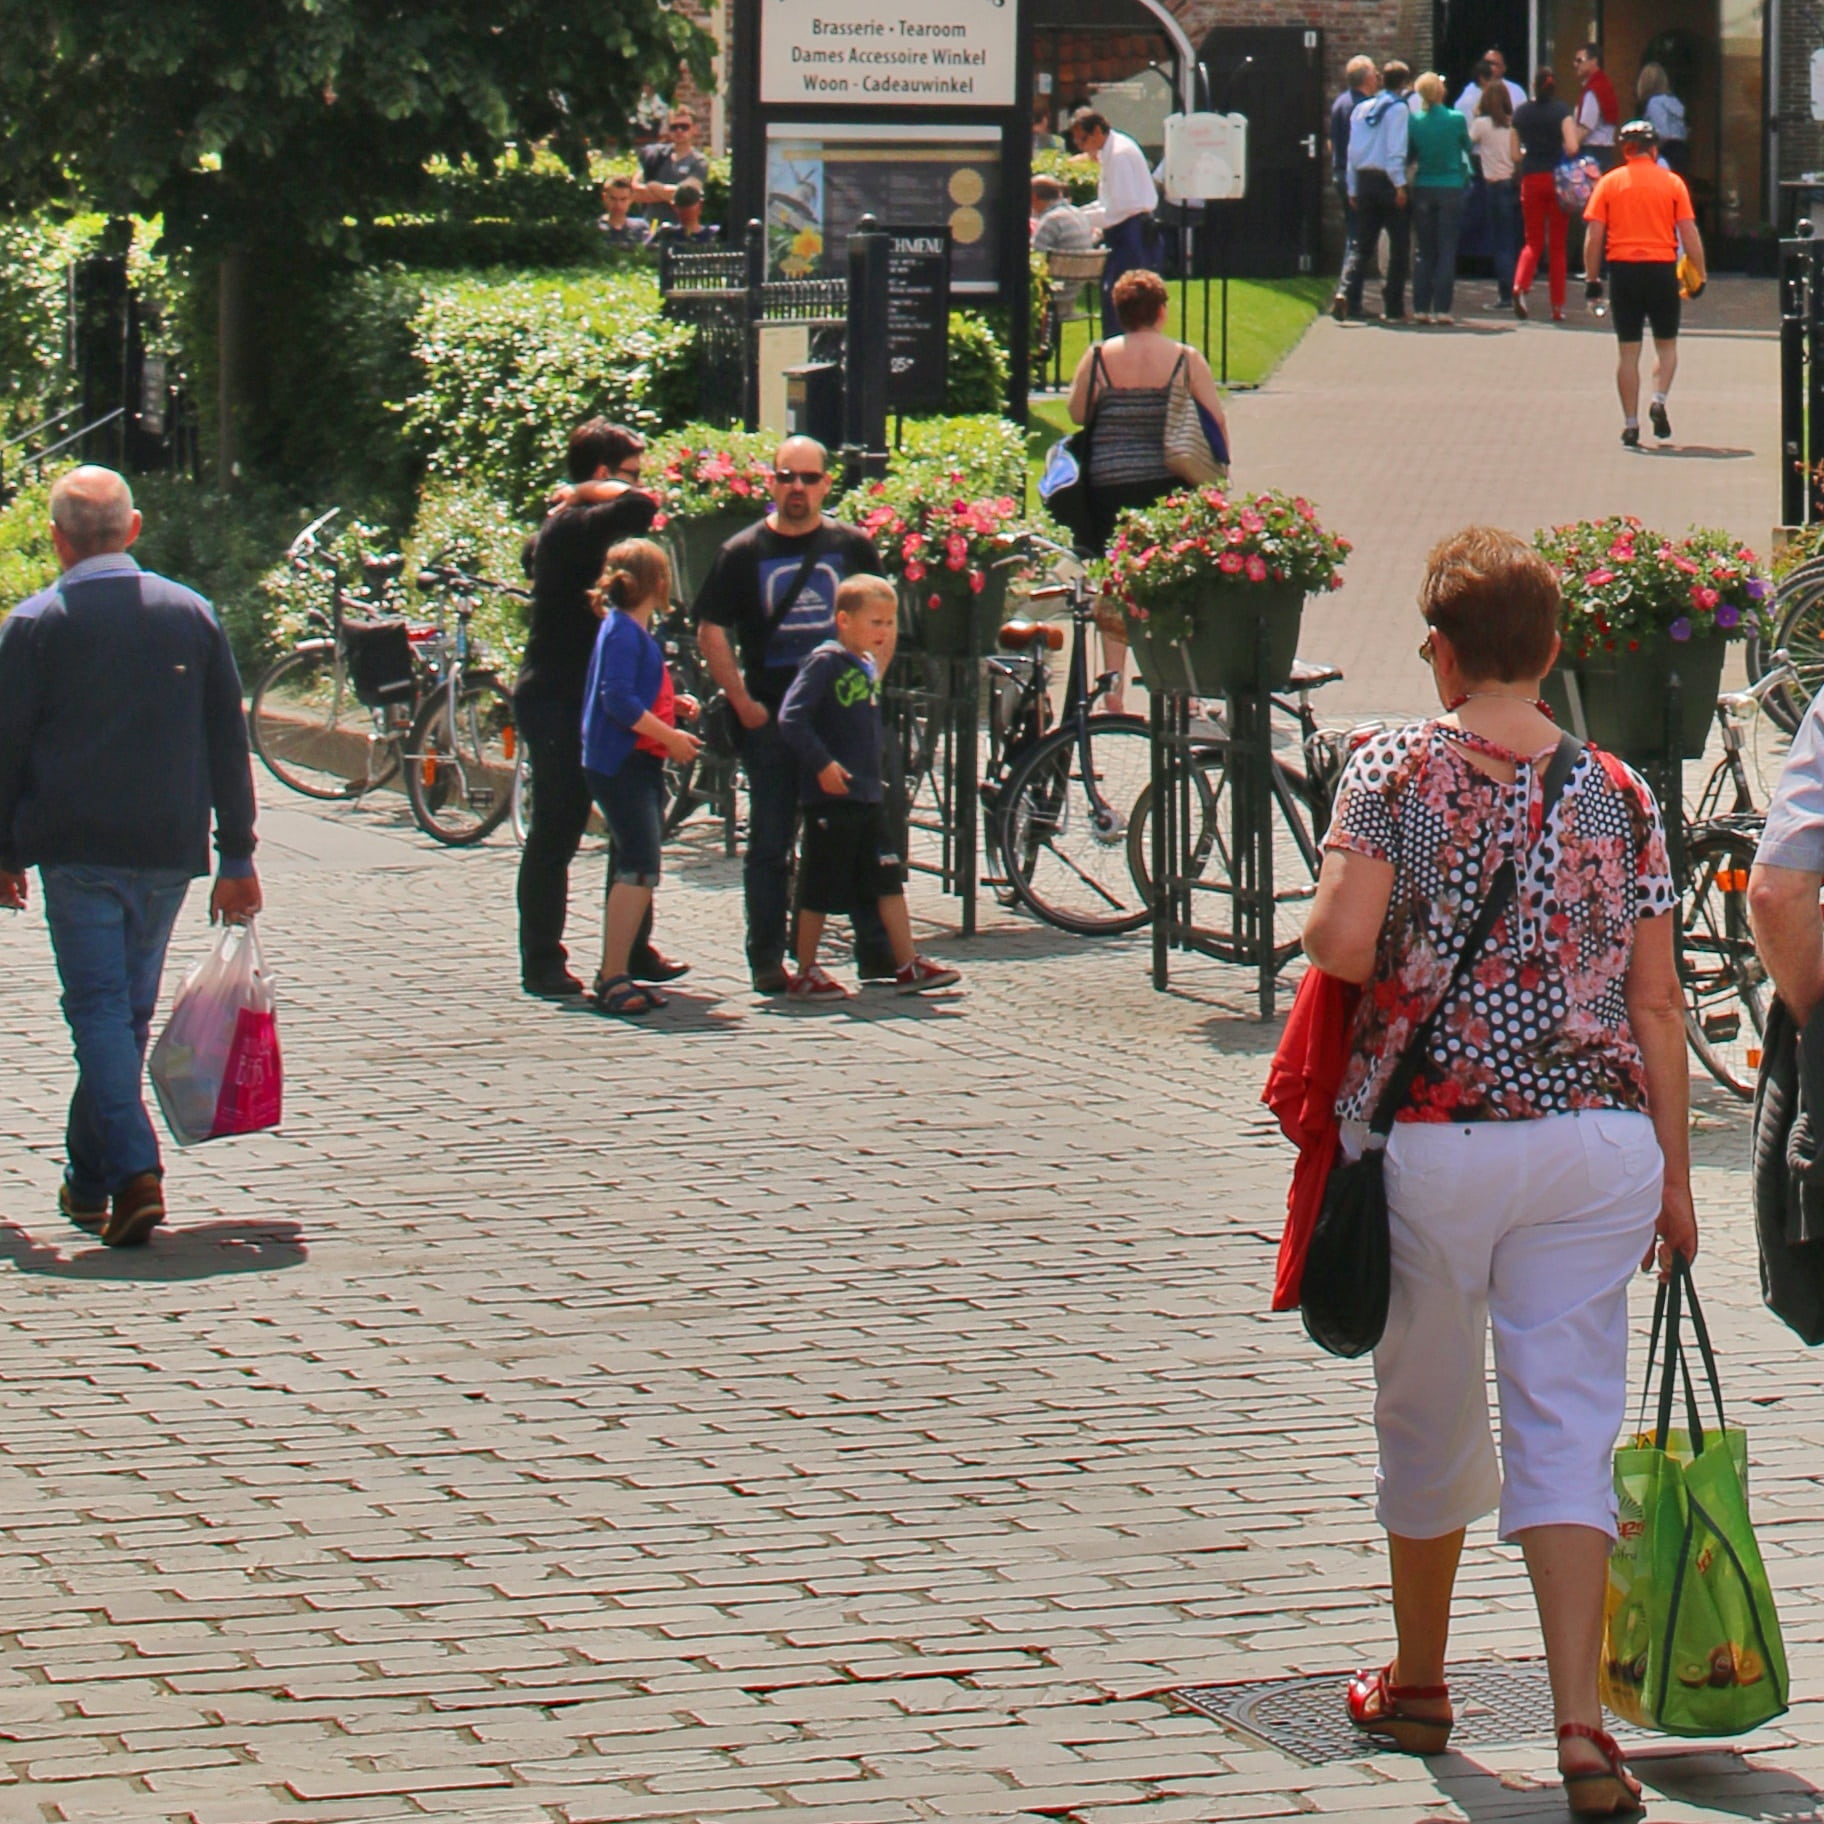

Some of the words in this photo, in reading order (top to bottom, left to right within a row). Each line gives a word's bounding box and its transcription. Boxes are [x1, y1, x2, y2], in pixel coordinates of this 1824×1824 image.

[812, 18, 884, 37] Brasserie
[899, 20, 966, 38] Tearoom
[791, 46, 844, 64] Dames
[849, 48, 928, 65] Accessoire
[932, 48, 986, 66] Winkel
[803, 74, 849, 92] Woon
[862, 75, 974, 94] Cadeauwinkel
